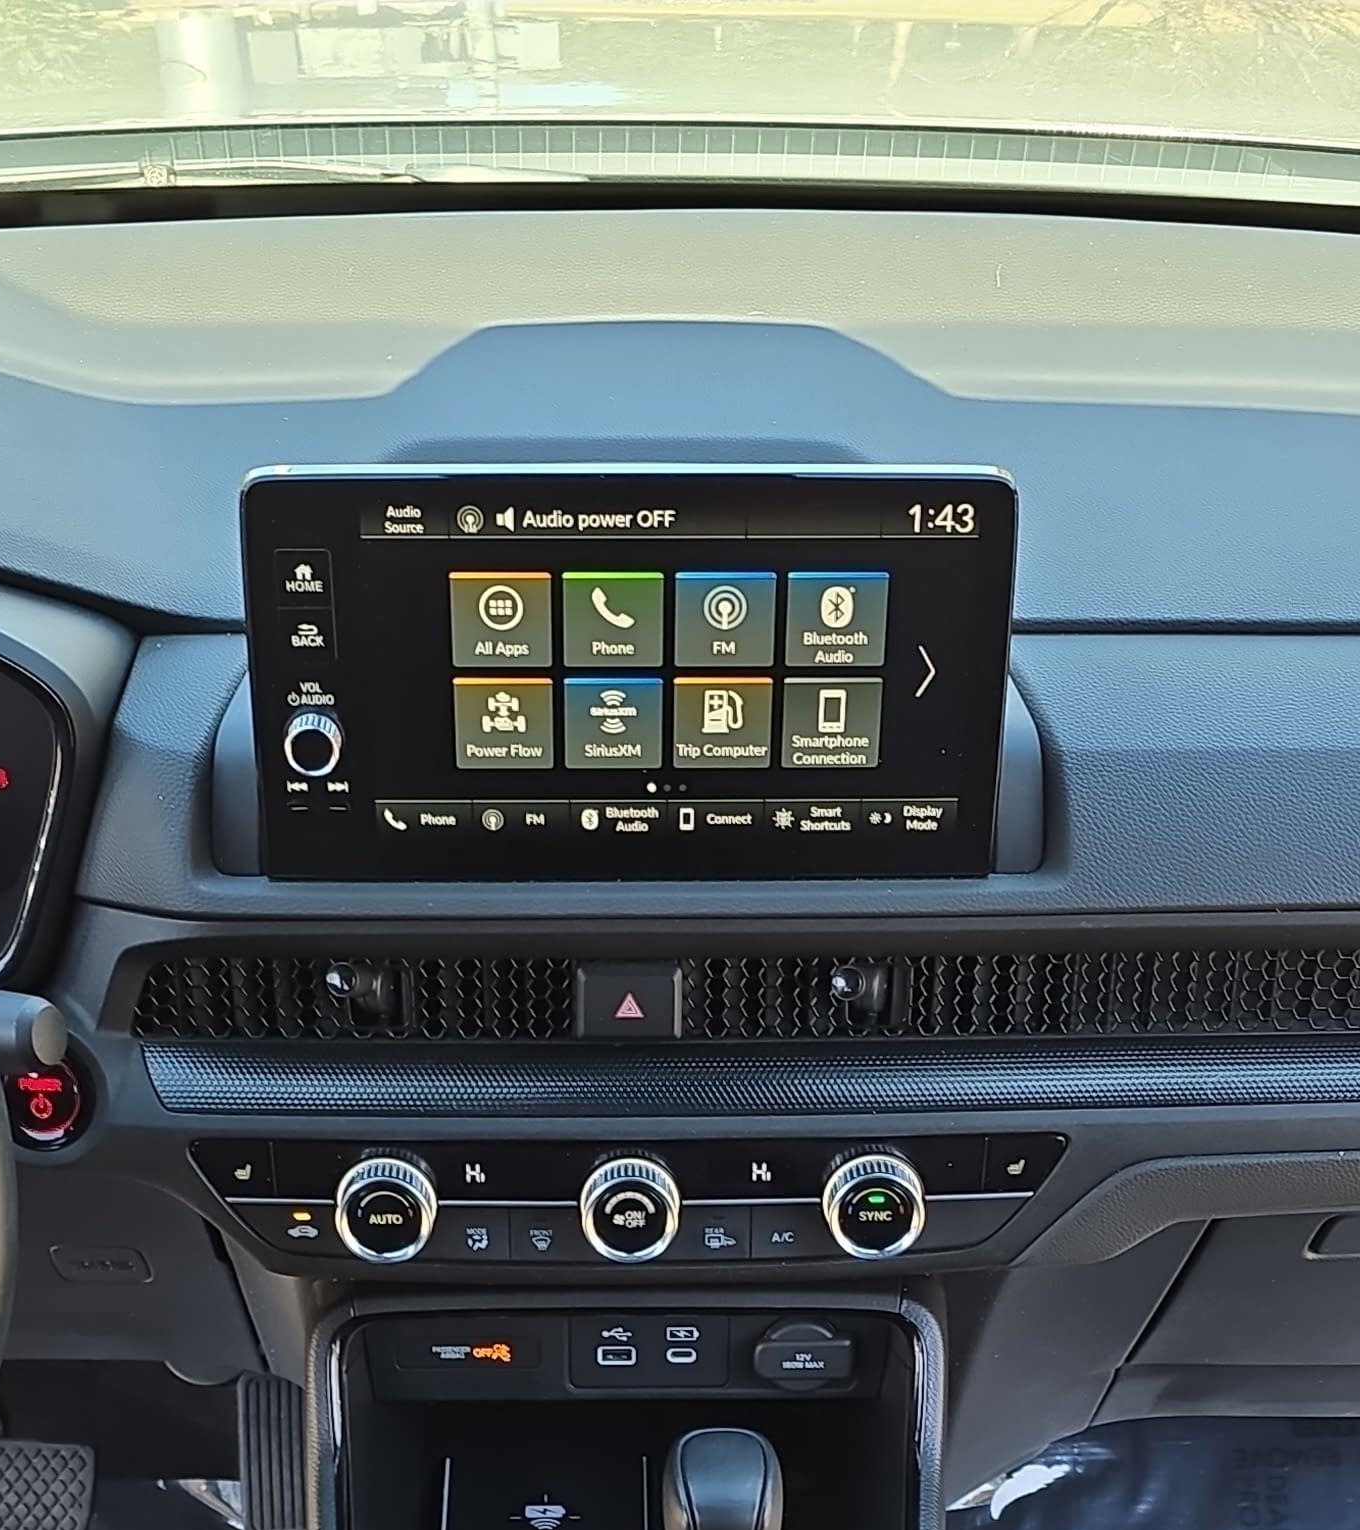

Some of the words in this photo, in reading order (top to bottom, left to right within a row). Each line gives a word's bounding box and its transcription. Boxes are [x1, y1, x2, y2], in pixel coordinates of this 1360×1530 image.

[385, 505, 421, 519] Audio
[908, 504, 975, 533] 1:43
[522, 510, 573, 528] Audio
[578, 512, 635, 530] power
[637, 510, 676, 527] OFF
[384, 521, 424, 534] Source
[286, 580, 323, 593] HOME
[290, 635, 325, 647] BACK
[803, 632, 868, 646] Bluetooth
[475, 642, 493, 655] All
[495, 642, 529, 658] Apps
[592, 642, 634, 655] Phone
[712, 641, 736, 654] FM
[814, 650, 853, 663] Audio
[300, 682, 323, 694] VOL
[301, 693, 334, 706] AUDIO
[792, 735, 869, 750] Smartphone
[466, 744, 507, 758] Power
[510, 744, 542, 757] Flow
[584, 744, 642, 758] SiriusXM
[677, 744, 702, 760] Trip
[703, 744, 768, 760] Computer
[793, 752, 866, 765] Connection
[606, 807, 658, 820] Bluetooth
[810, 806, 842, 818] Smart
[903, 806, 943, 820] Display
[420, 813, 456, 825] Phone
[526, 814, 545, 825] FM
[707, 814, 752, 825] Connect
[800, 820, 851, 831] Shortcuts
[906, 820, 938, 831] Mode
[615, 820, 649, 832] Audio
[369, 1213, 404, 1225] AUTO
[858, 1210, 893, 1222] SYNC
[626, 1219, 647, 1228] OFF
[771, 1231, 794, 1243] A/C
